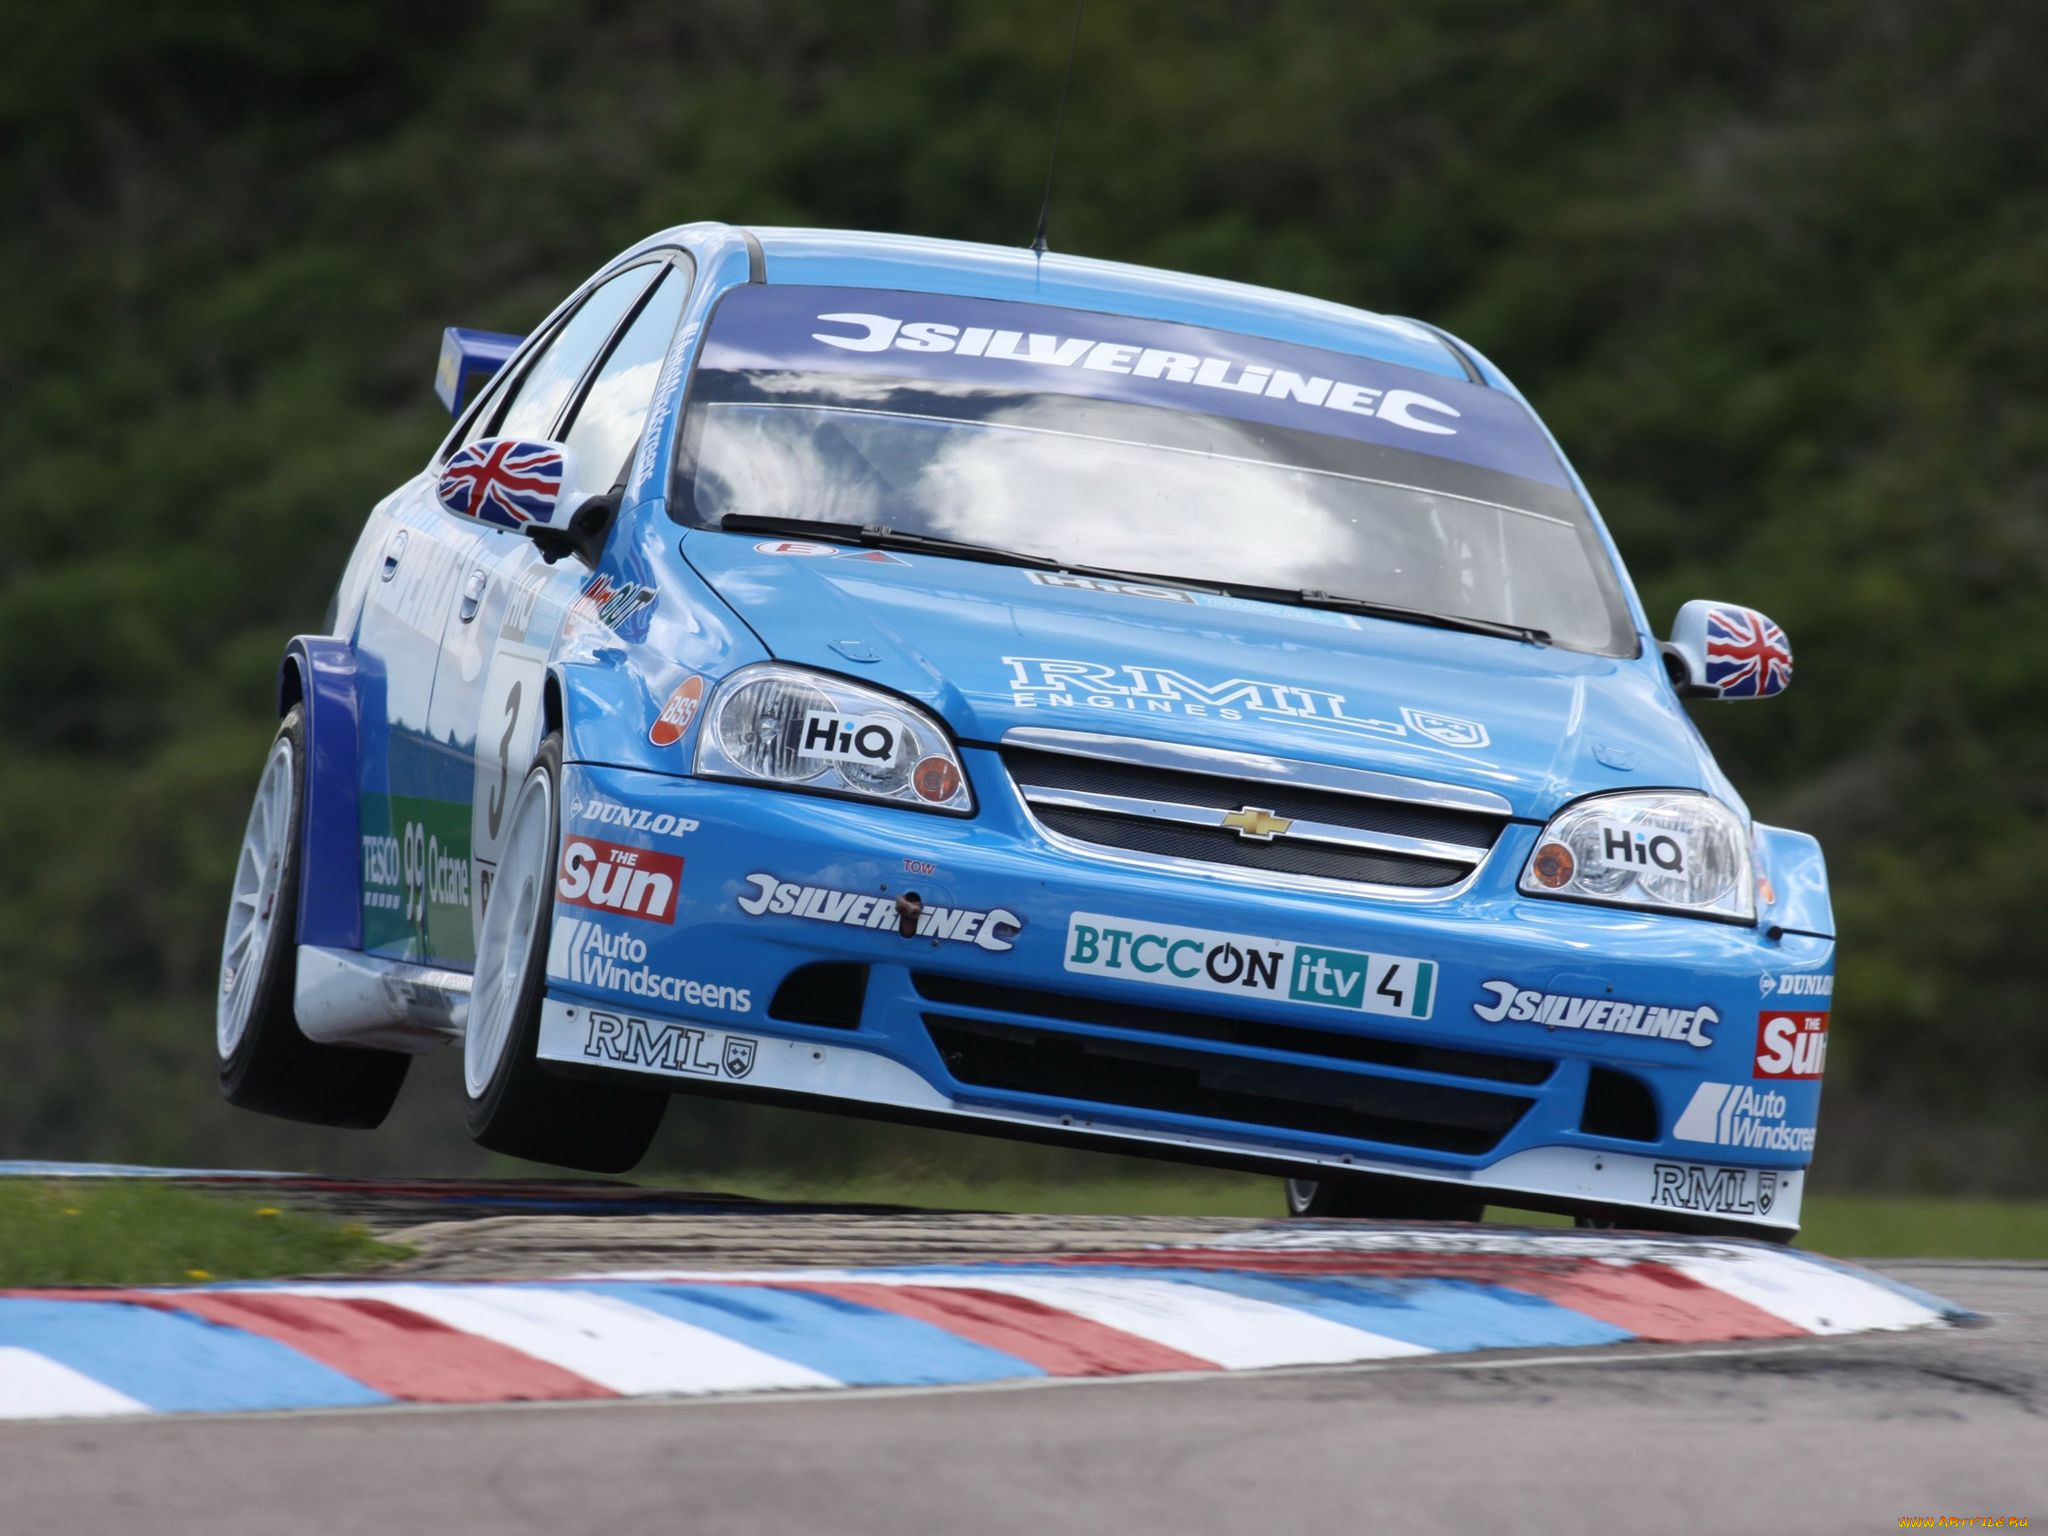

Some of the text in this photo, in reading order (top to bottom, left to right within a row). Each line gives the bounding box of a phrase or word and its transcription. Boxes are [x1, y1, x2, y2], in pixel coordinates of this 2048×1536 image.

[1002, 656, 1406, 737] RML
[1013, 693, 1242, 721] ENGINES
[489, 680, 522, 841] 3
[804, 717, 894, 761] HiQ
[583, 800, 700, 837] DUNLOP
[363, 834, 400, 887] TESCO
[404, 820, 425, 922] 99
[428, 834, 469, 907] Octane
[609, 849, 639, 867] THE
[903, 858, 936, 876] TOW
[1603, 827, 1684, 874] HiQ
[559, 842, 673, 917] Sun
[585, 922, 647, 964] Auto
[583, 952, 752, 1014] Windscreens
[1299, 954, 1361, 998] itv
[1377, 964, 1404, 1007] 4
[584, 1011, 719, 1077] RML
[1804, 1017, 1821, 1031] THE
[1735, 1085, 1786, 1119] Auto
[1651, 1163, 1754, 1216] RML
